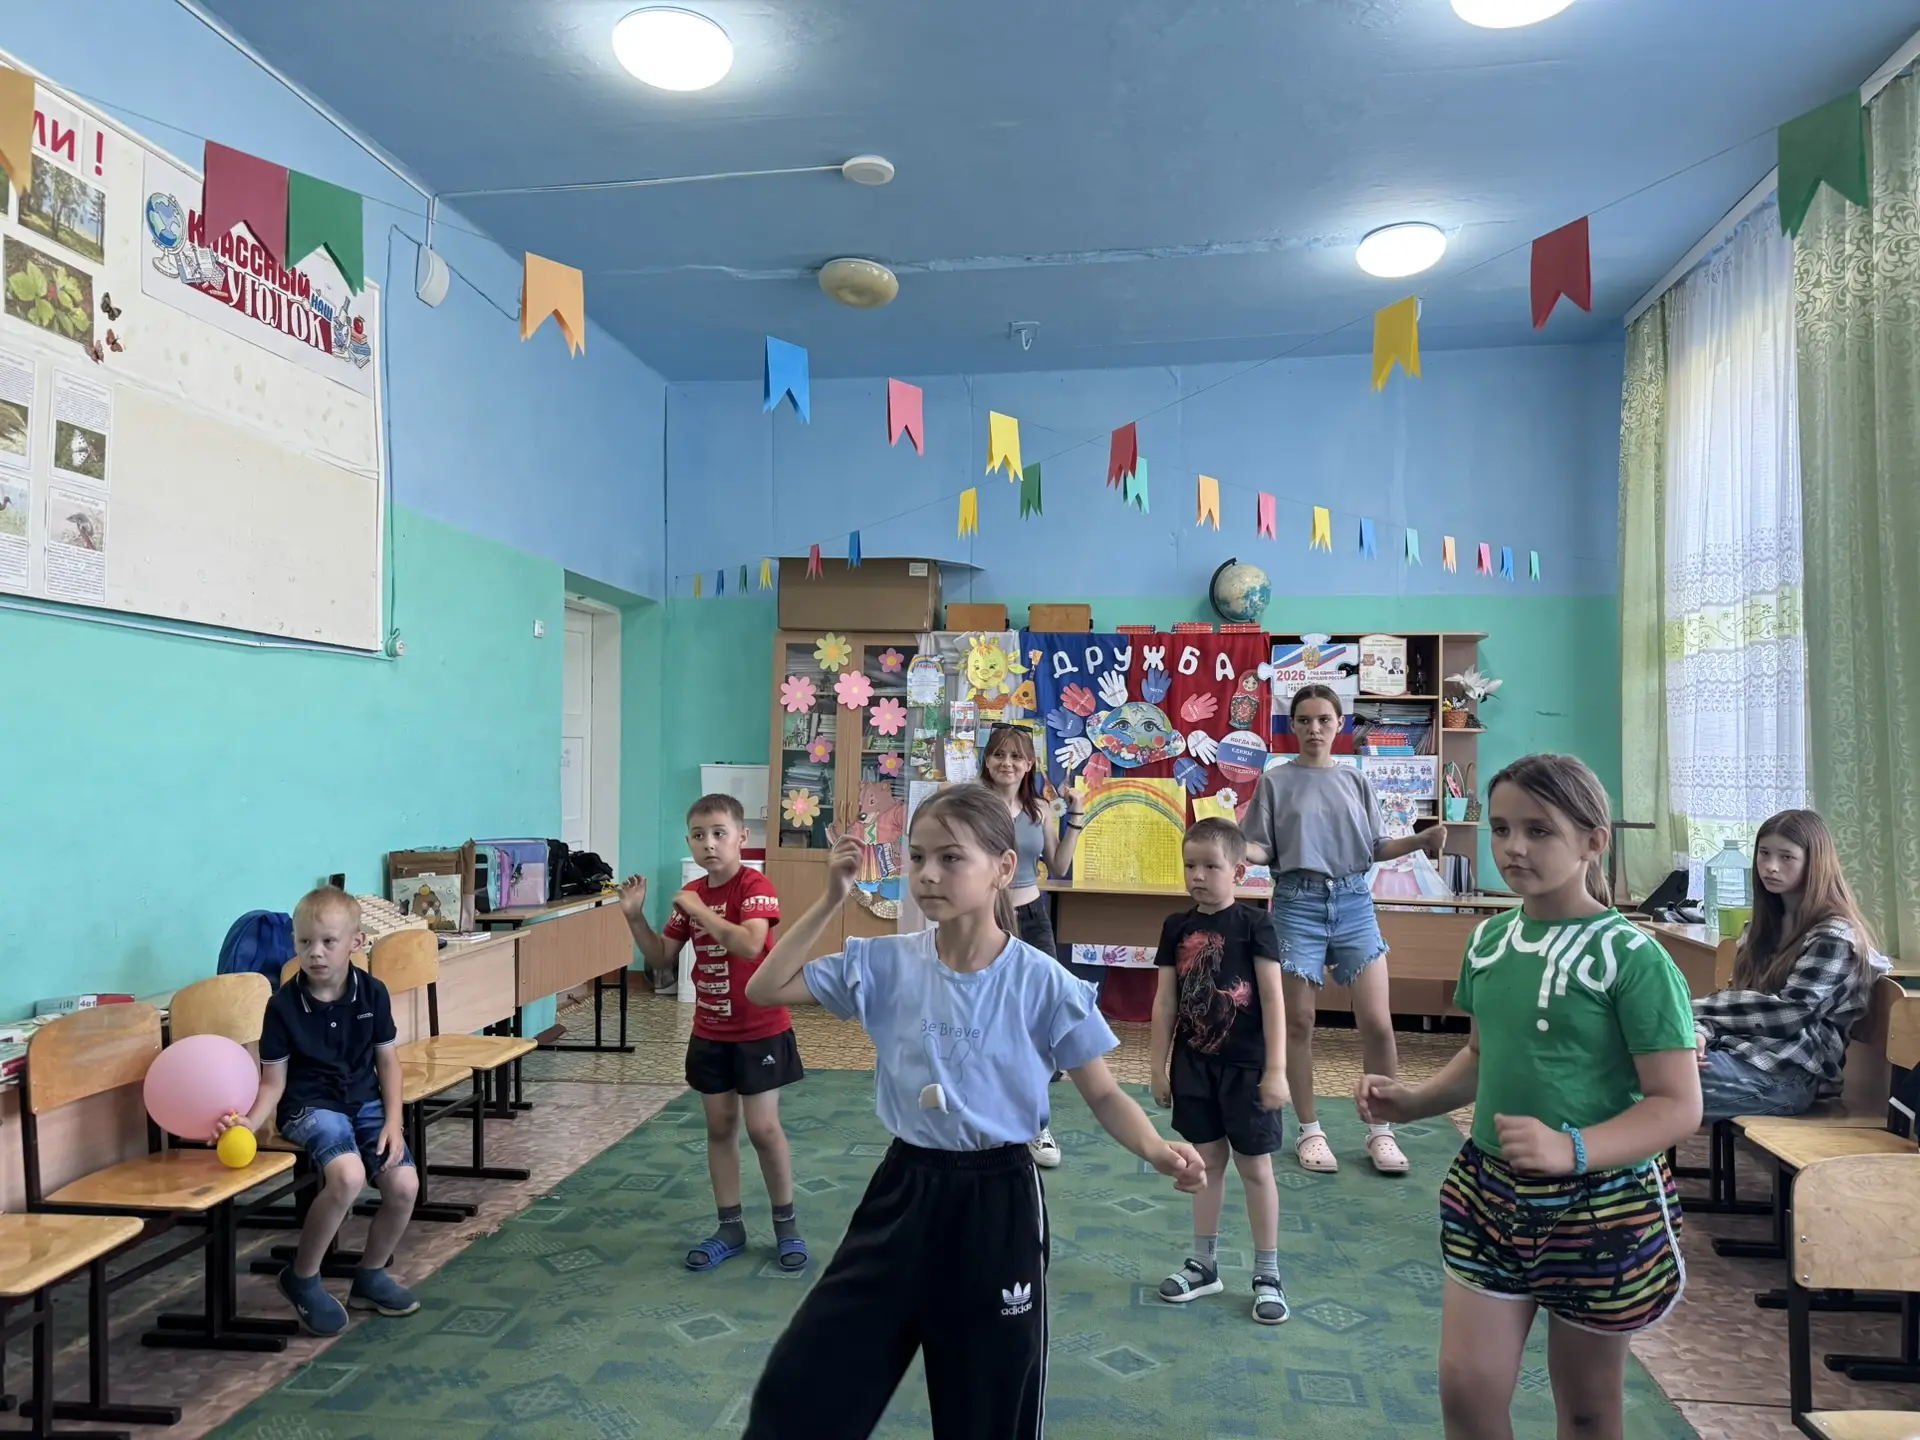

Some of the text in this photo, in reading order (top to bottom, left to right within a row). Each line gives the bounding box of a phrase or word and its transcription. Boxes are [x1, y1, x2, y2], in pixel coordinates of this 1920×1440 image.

[227, 266, 326, 352] УГОЛОК
[311, 293, 333, 321] НАШ
[1053, 645, 1235, 681] ДРУЖБА
[1276, 670, 1306, 681] 2026
[1230, 737, 1250, 746] КОГДА
[921, 1018, 981, 1039] Be Brave
[1001, 1301, 1033, 1316] adidas
